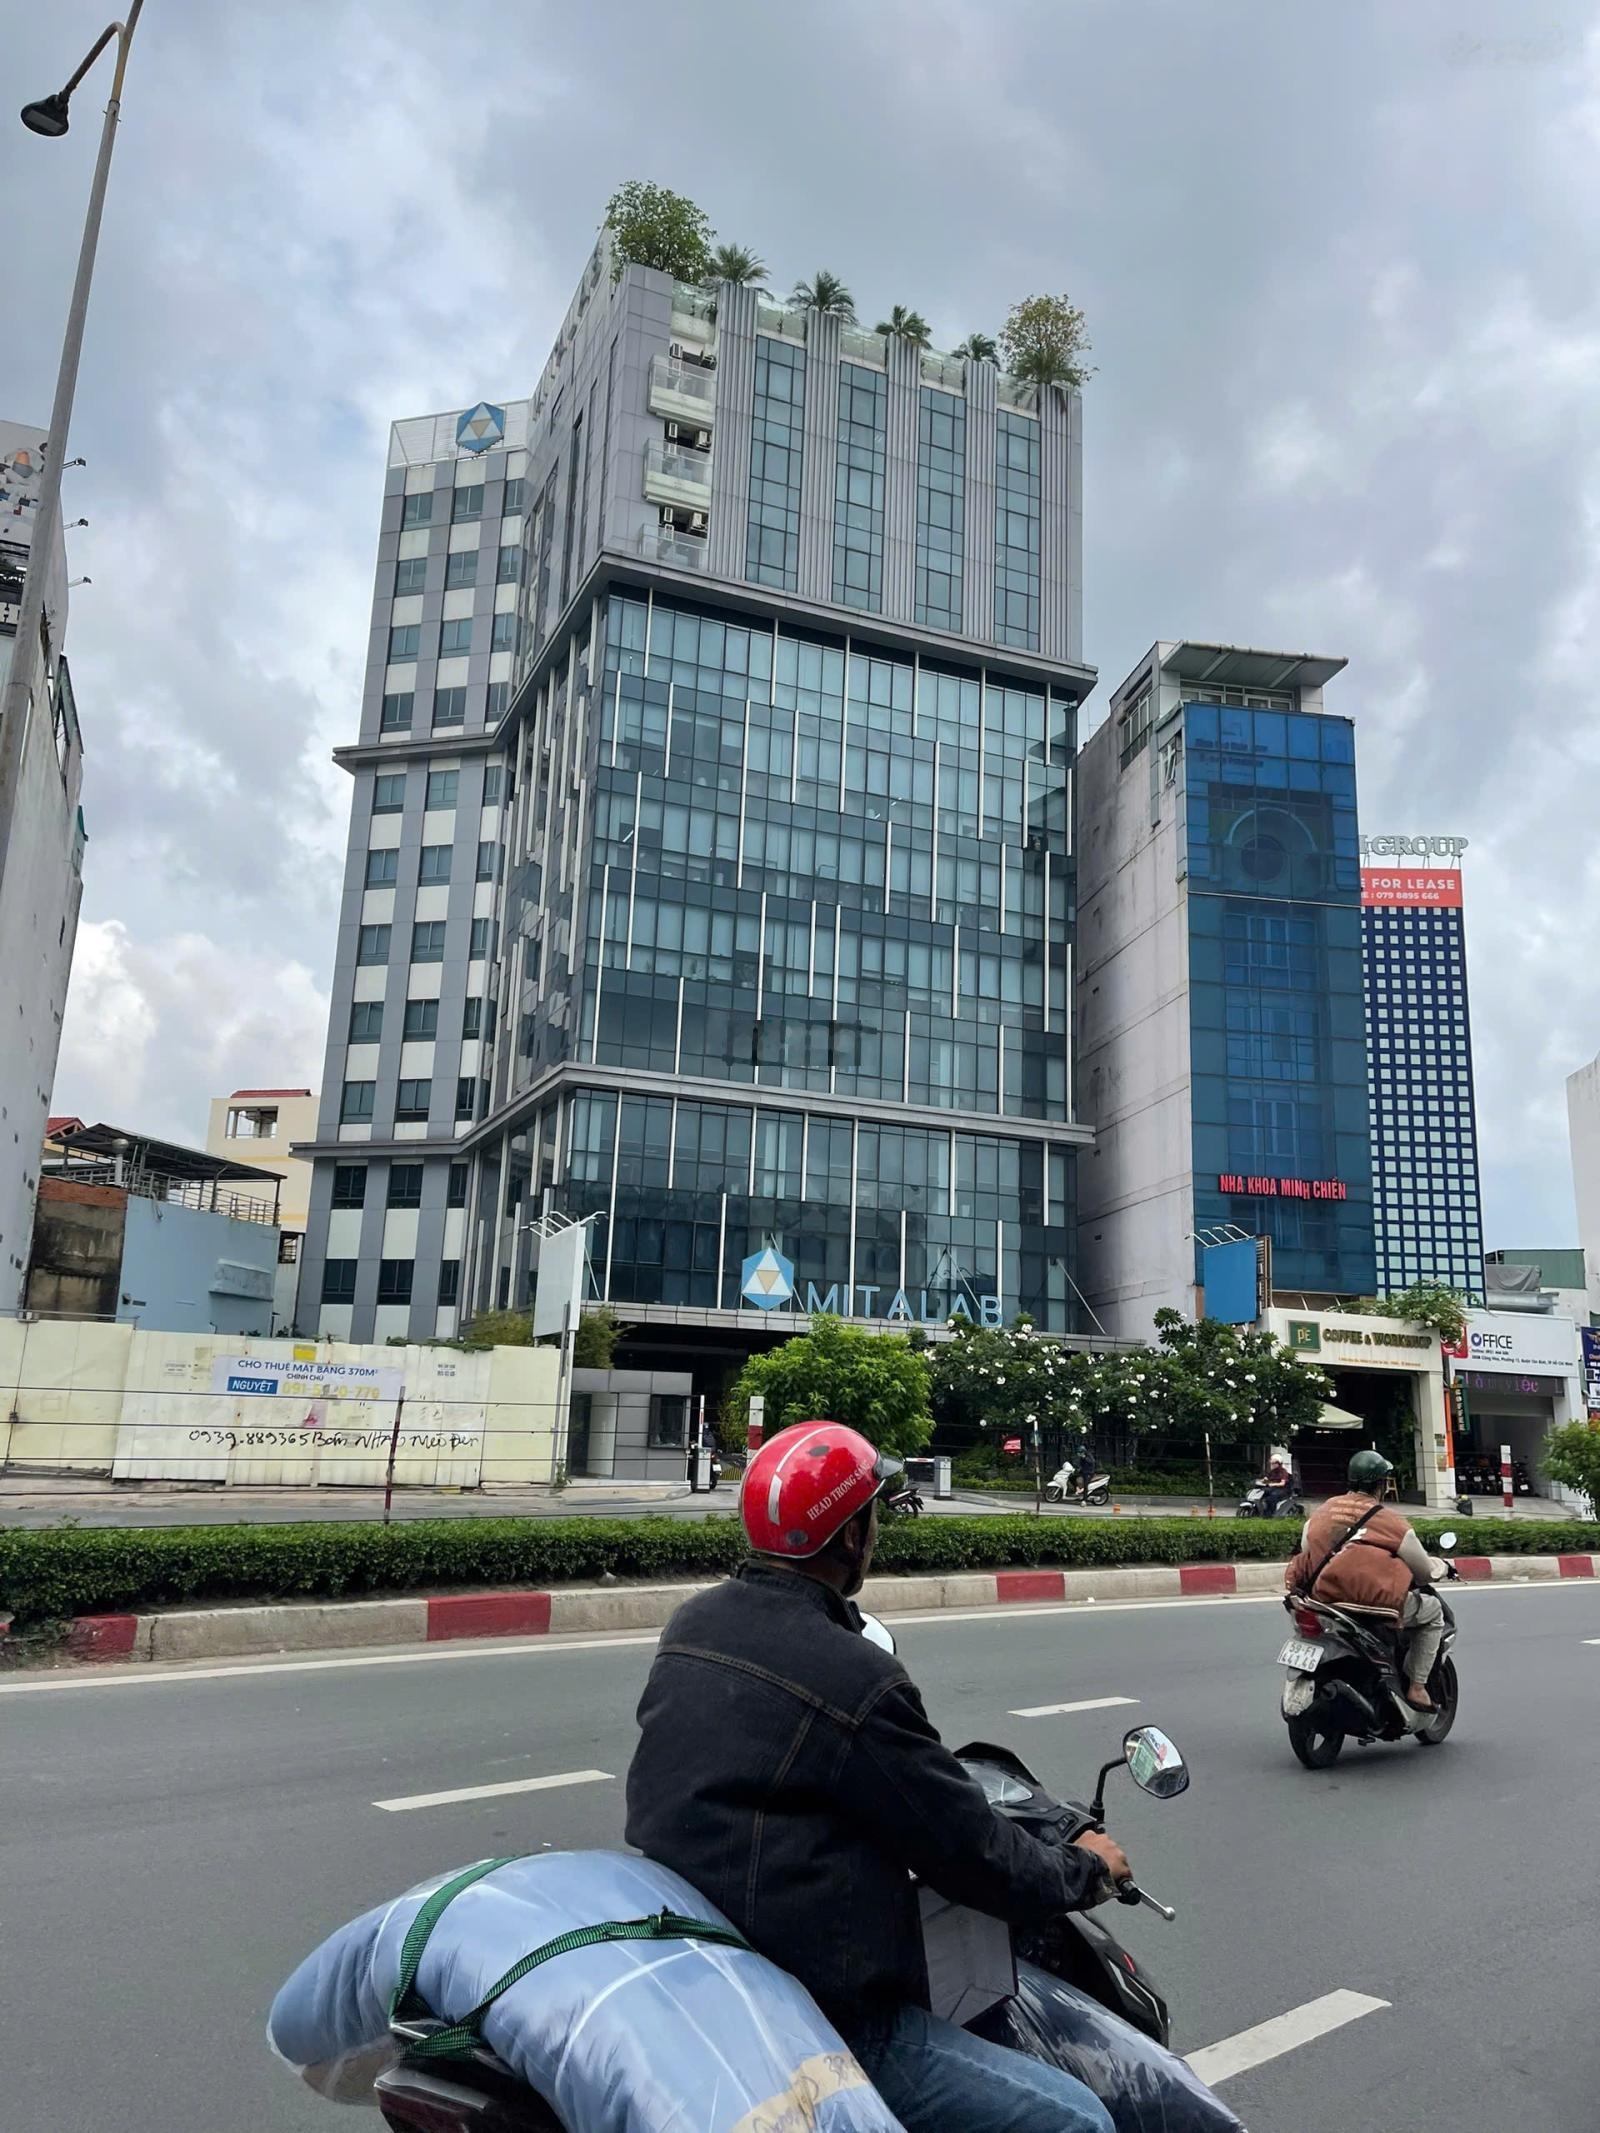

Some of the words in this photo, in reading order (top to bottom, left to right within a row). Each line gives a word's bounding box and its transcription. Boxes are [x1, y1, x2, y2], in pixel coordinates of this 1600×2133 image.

[1371, 835, 1469, 857] GROUP
[1372, 879, 1401, 888] FOR
[1408, 879, 1455, 889] LEASE
[1220, 1175, 1244, 1193] NHA
[1247, 1177, 1277, 1195] KHOA
[1281, 1179, 1310, 1200] MINH
[807, 1281, 1003, 1328] MITALAB
[1322, 1329, 1362, 1344] COFFEE
[1371, 1332, 1432, 1349] WORKSHOP
[238, 1360, 262, 1369] CHO
[807, 1497, 832, 1520] HEAD
[830, 1475, 857, 1501] TRONG
